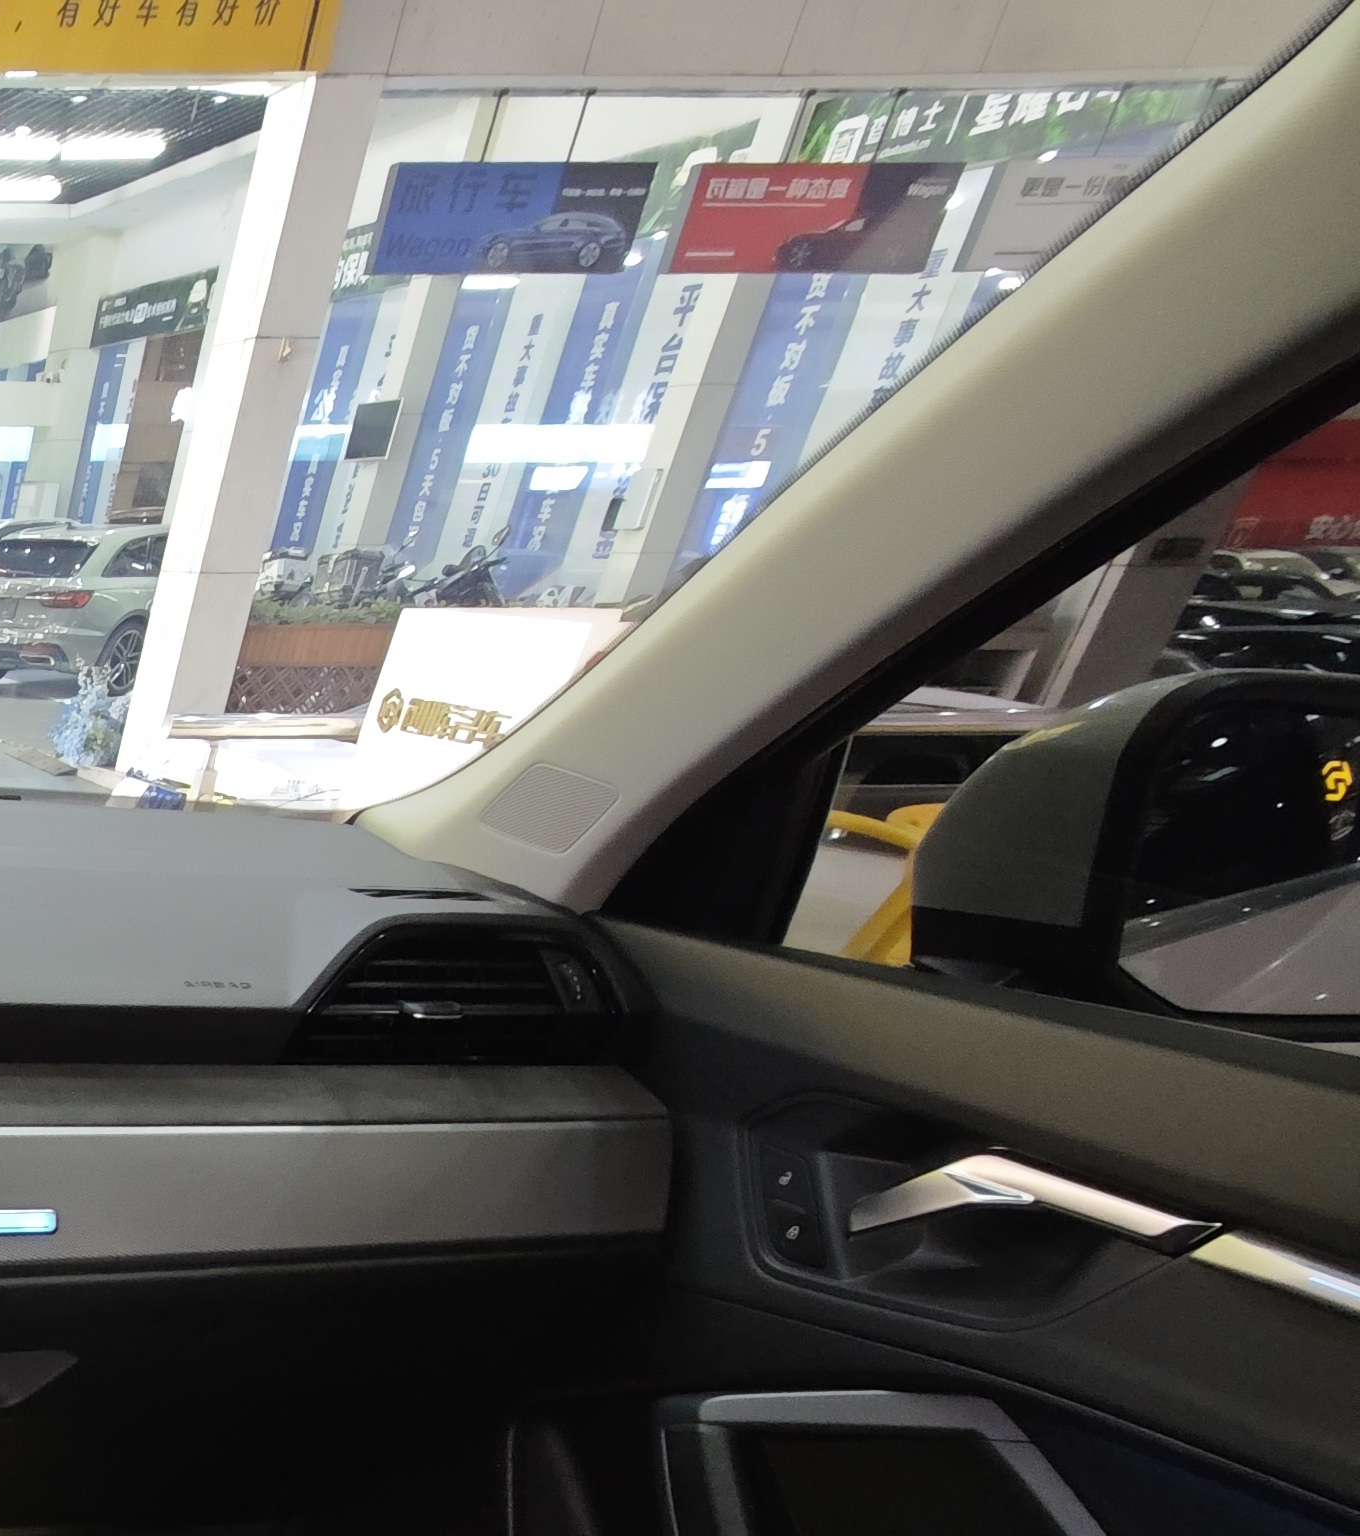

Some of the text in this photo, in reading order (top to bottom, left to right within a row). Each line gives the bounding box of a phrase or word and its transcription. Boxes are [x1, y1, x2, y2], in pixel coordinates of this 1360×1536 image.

[397, 170, 538, 215] 旅行车
[906, 181, 948, 199] Wagon
